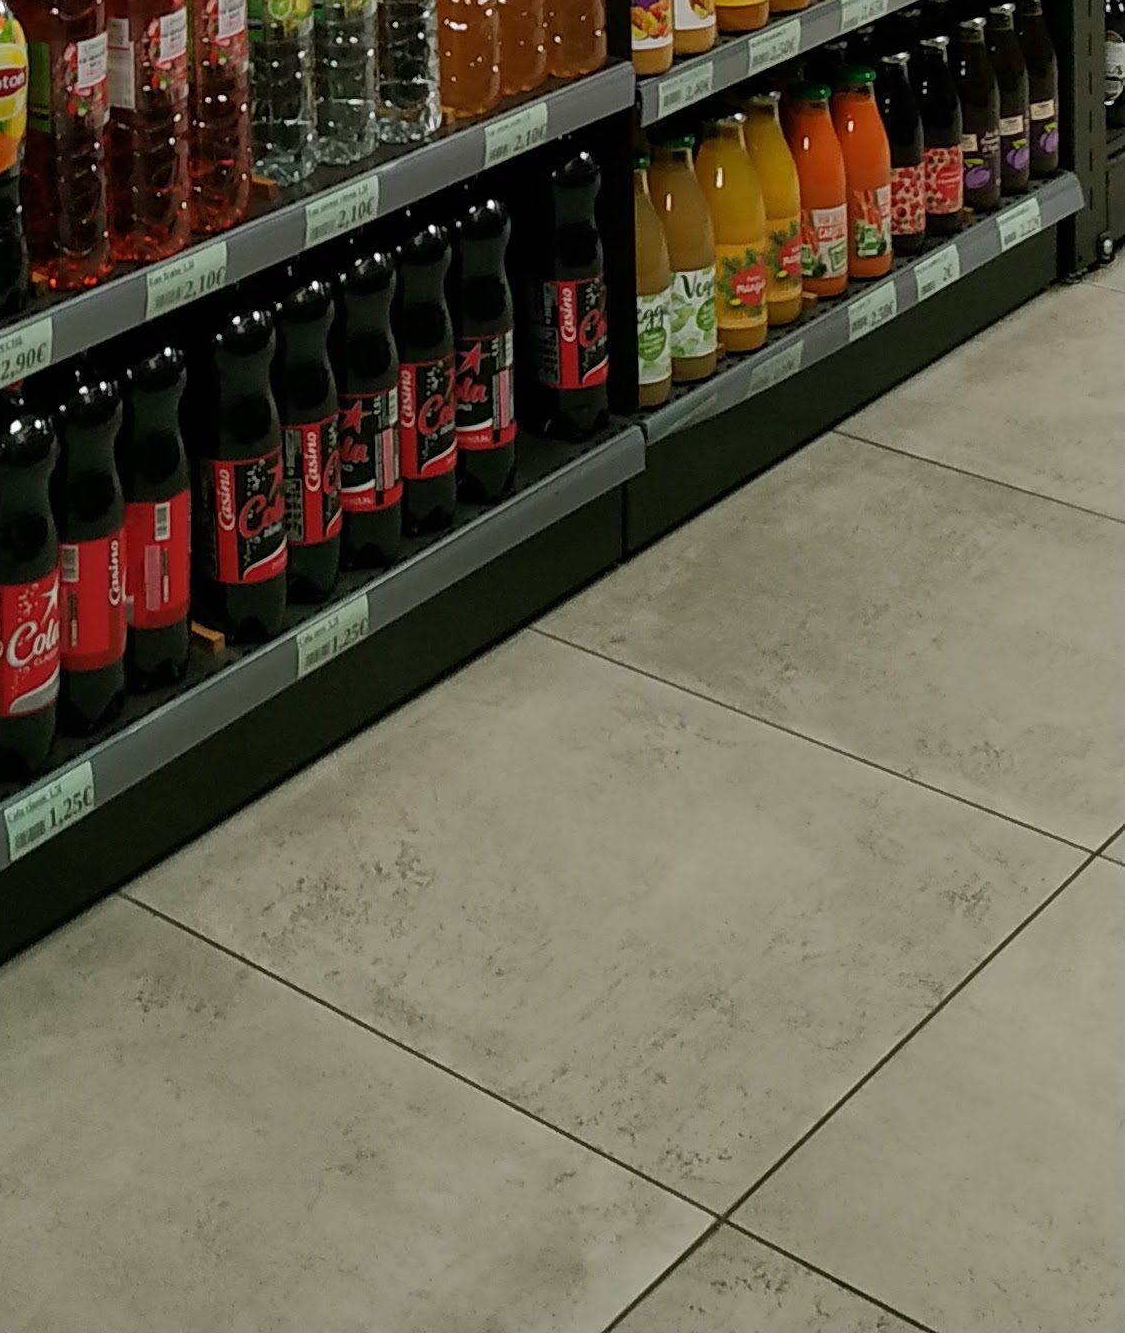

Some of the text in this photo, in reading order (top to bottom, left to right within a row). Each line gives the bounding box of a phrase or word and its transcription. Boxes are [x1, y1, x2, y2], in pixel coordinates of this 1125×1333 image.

[337, 194, 375, 228] 2,10€
[184, 265, 226, 303] 2,10€
[561, 286, 577, 343] Casino
[1, 341, 49, 383] 2,90€
[400, 369, 416, 429] Casino
[305, 431, 322, 493] Casino
[217, 468, 236, 532] Casino
[108, 539, 122, 606] Casino
[47, 786, 94, 832] 1,25€
